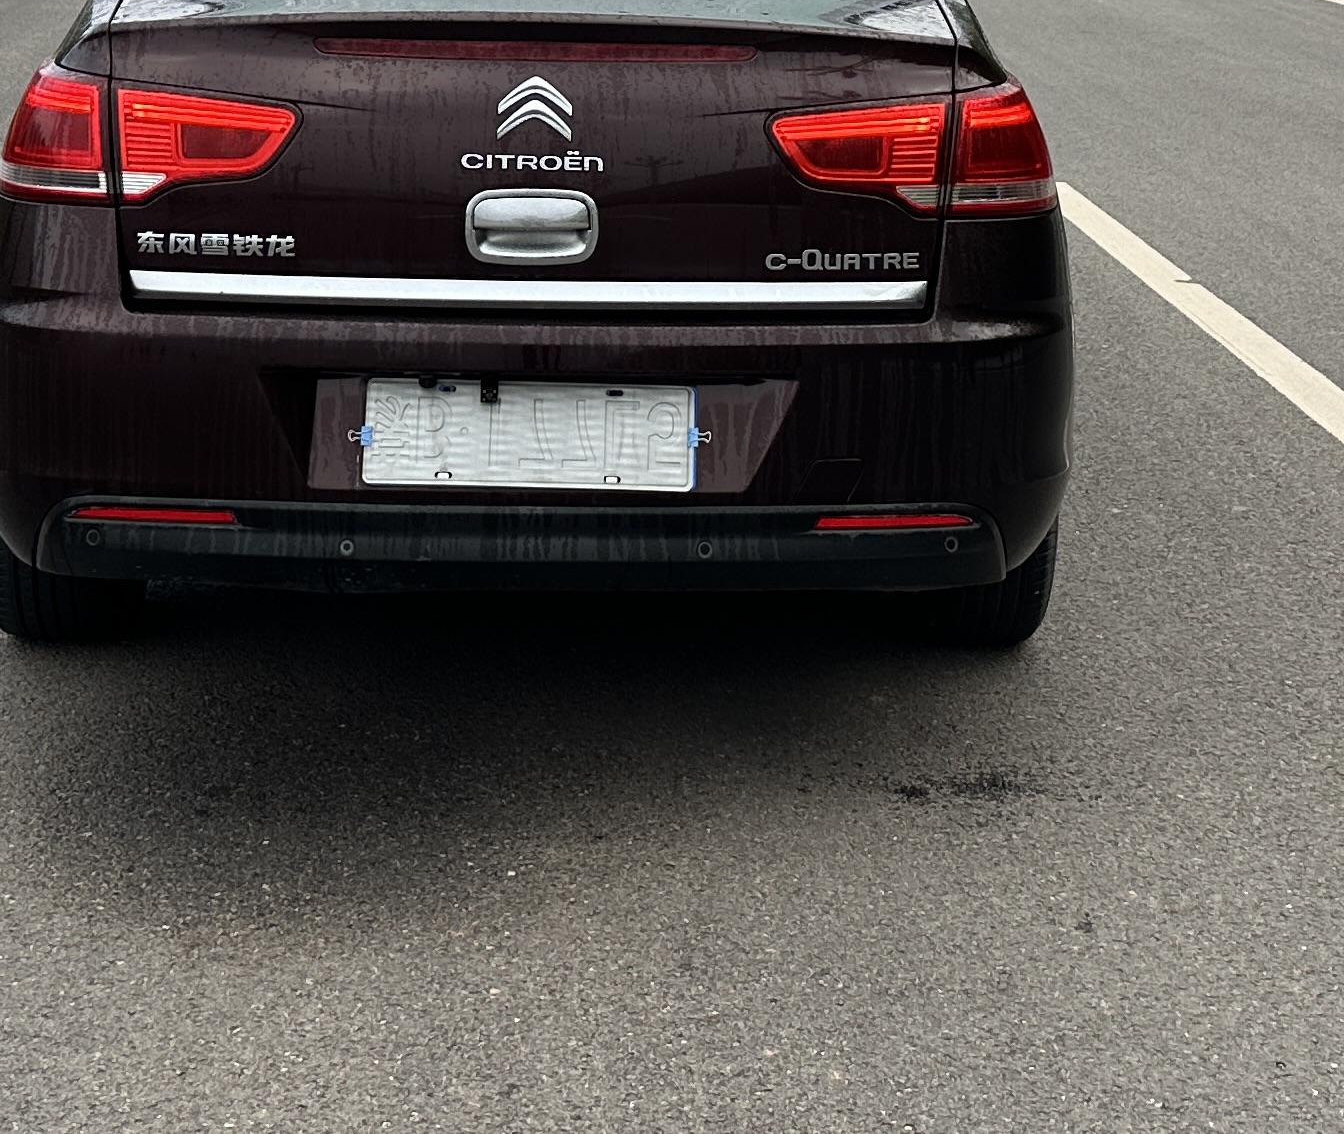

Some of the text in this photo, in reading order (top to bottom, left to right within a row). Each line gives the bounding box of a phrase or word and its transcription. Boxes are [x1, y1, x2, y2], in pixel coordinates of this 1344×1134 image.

[460, 150, 604, 172] CITROËN
[136, 230, 296, 257] 东风雪铁龙
[765, 248, 920, 271] C-QUATRE
